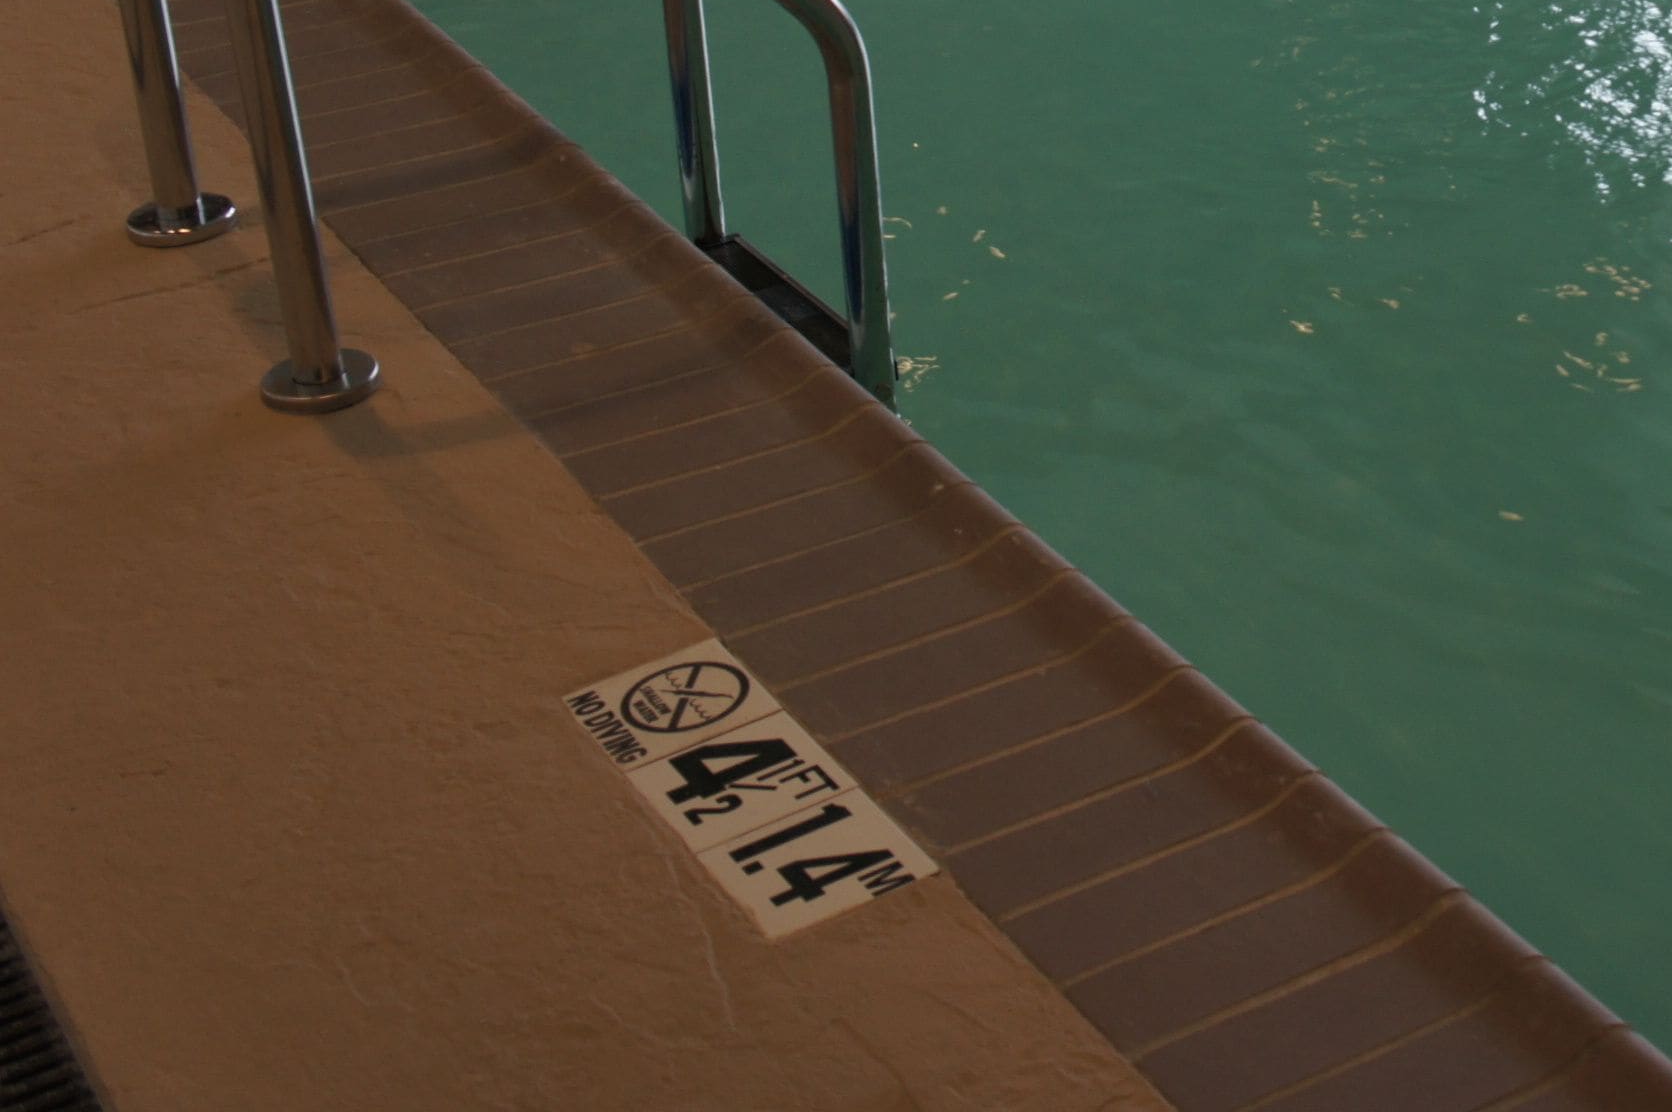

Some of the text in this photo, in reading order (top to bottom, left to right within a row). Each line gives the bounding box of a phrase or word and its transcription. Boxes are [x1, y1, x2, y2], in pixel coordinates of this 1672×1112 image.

[567, 690, 648, 764] NO DIVING
[779, 764, 839, 800] FT
[728, 802, 916, 907] 1.4 M
